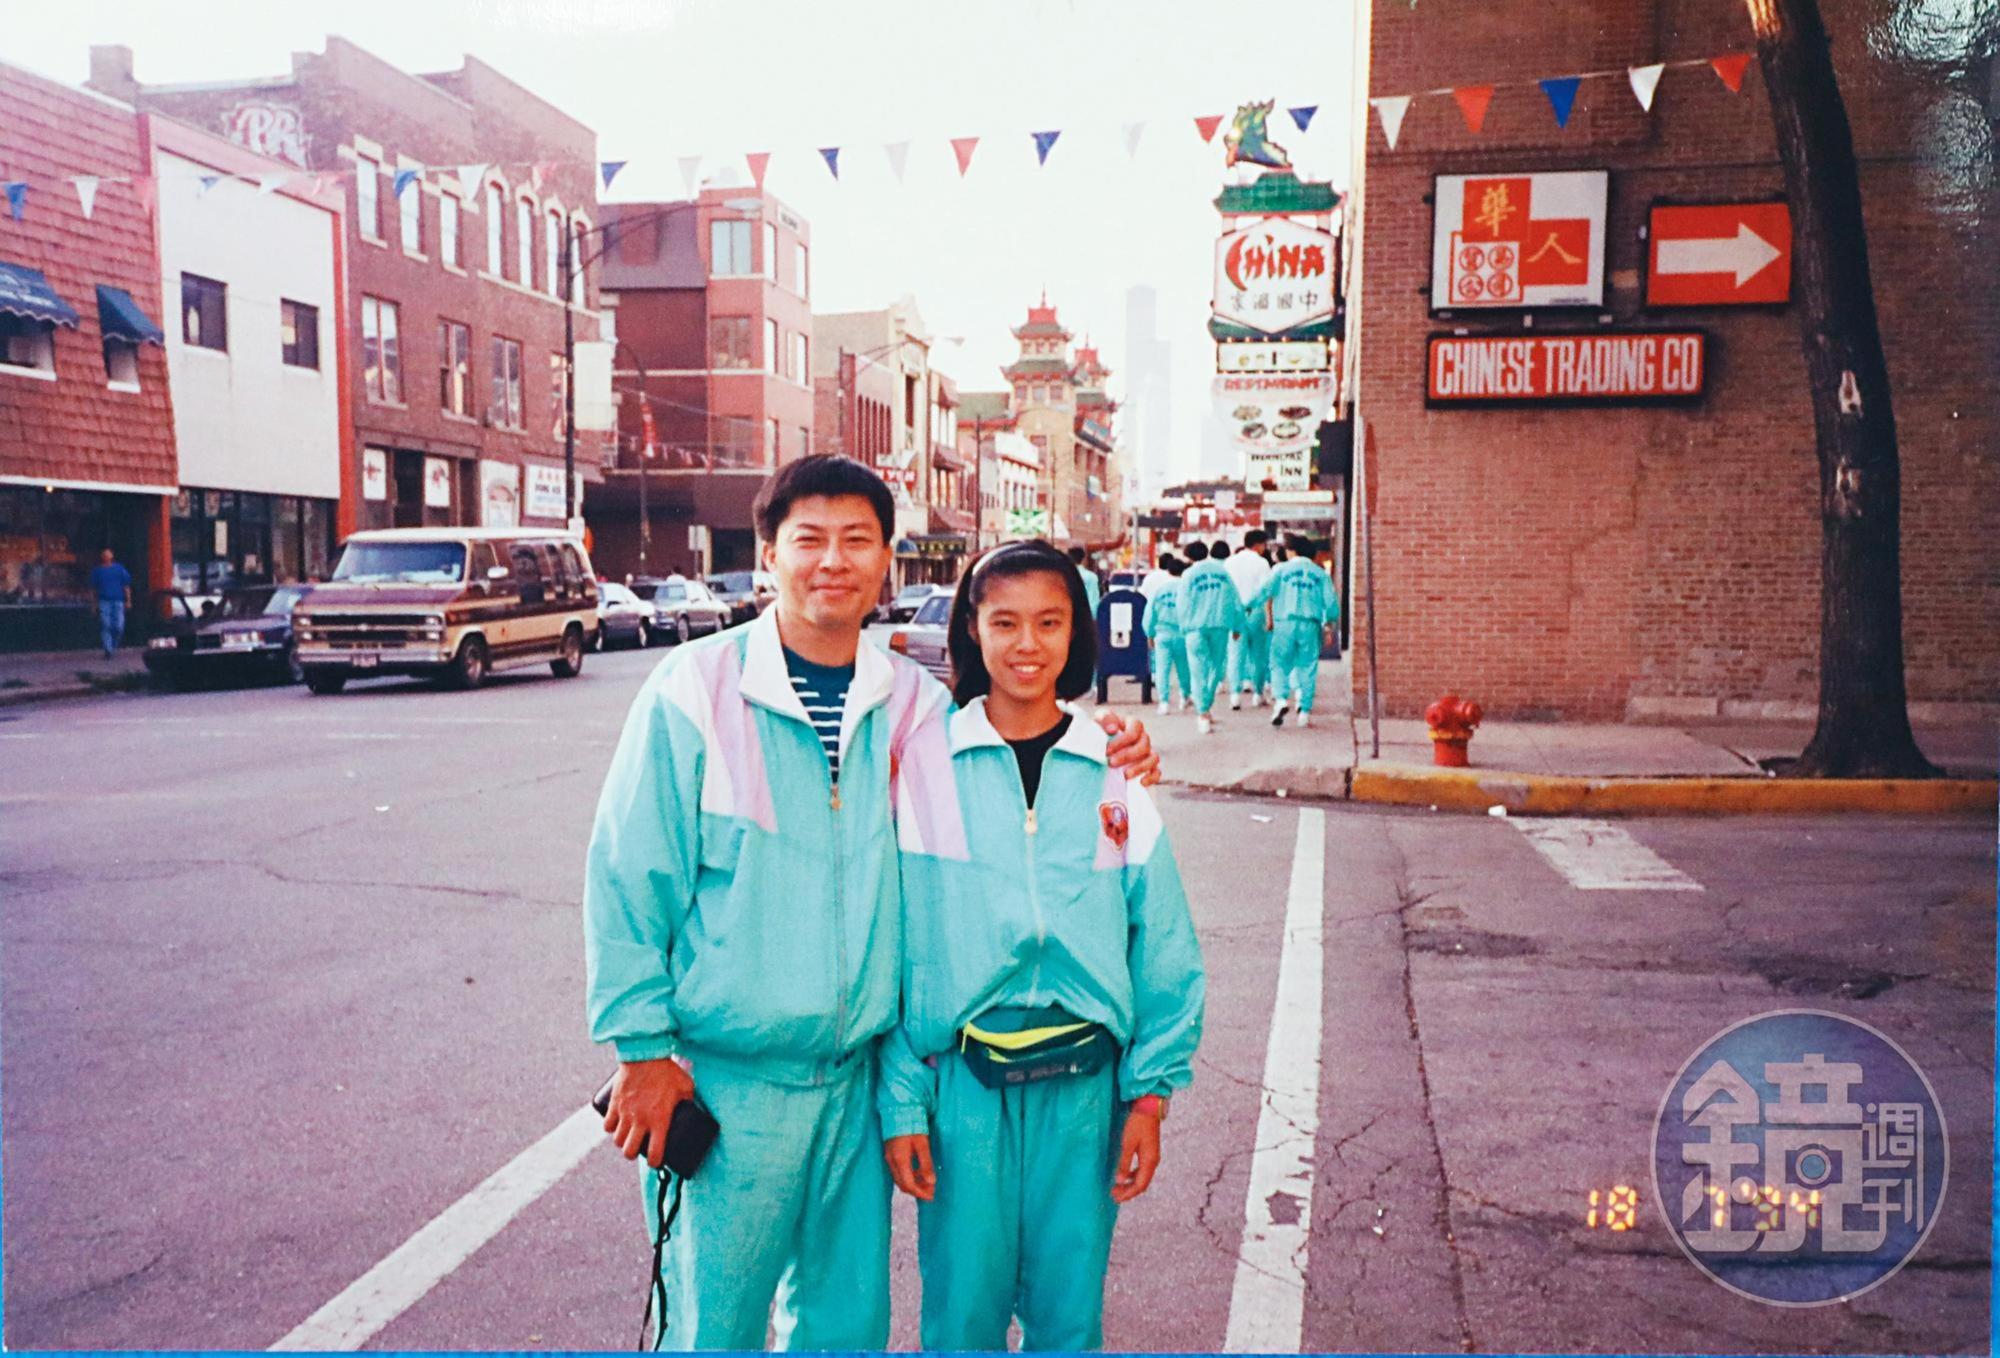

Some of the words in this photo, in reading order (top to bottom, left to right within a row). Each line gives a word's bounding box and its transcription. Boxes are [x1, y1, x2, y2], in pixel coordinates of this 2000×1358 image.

[1474, 182, 1517, 238] 華
[1526, 232, 1583, 264] 人
[1435, 340, 1536, 395] CHINESE
[1542, 338, 1656, 394] TRADING
[1661, 336, 1700, 391] CO
